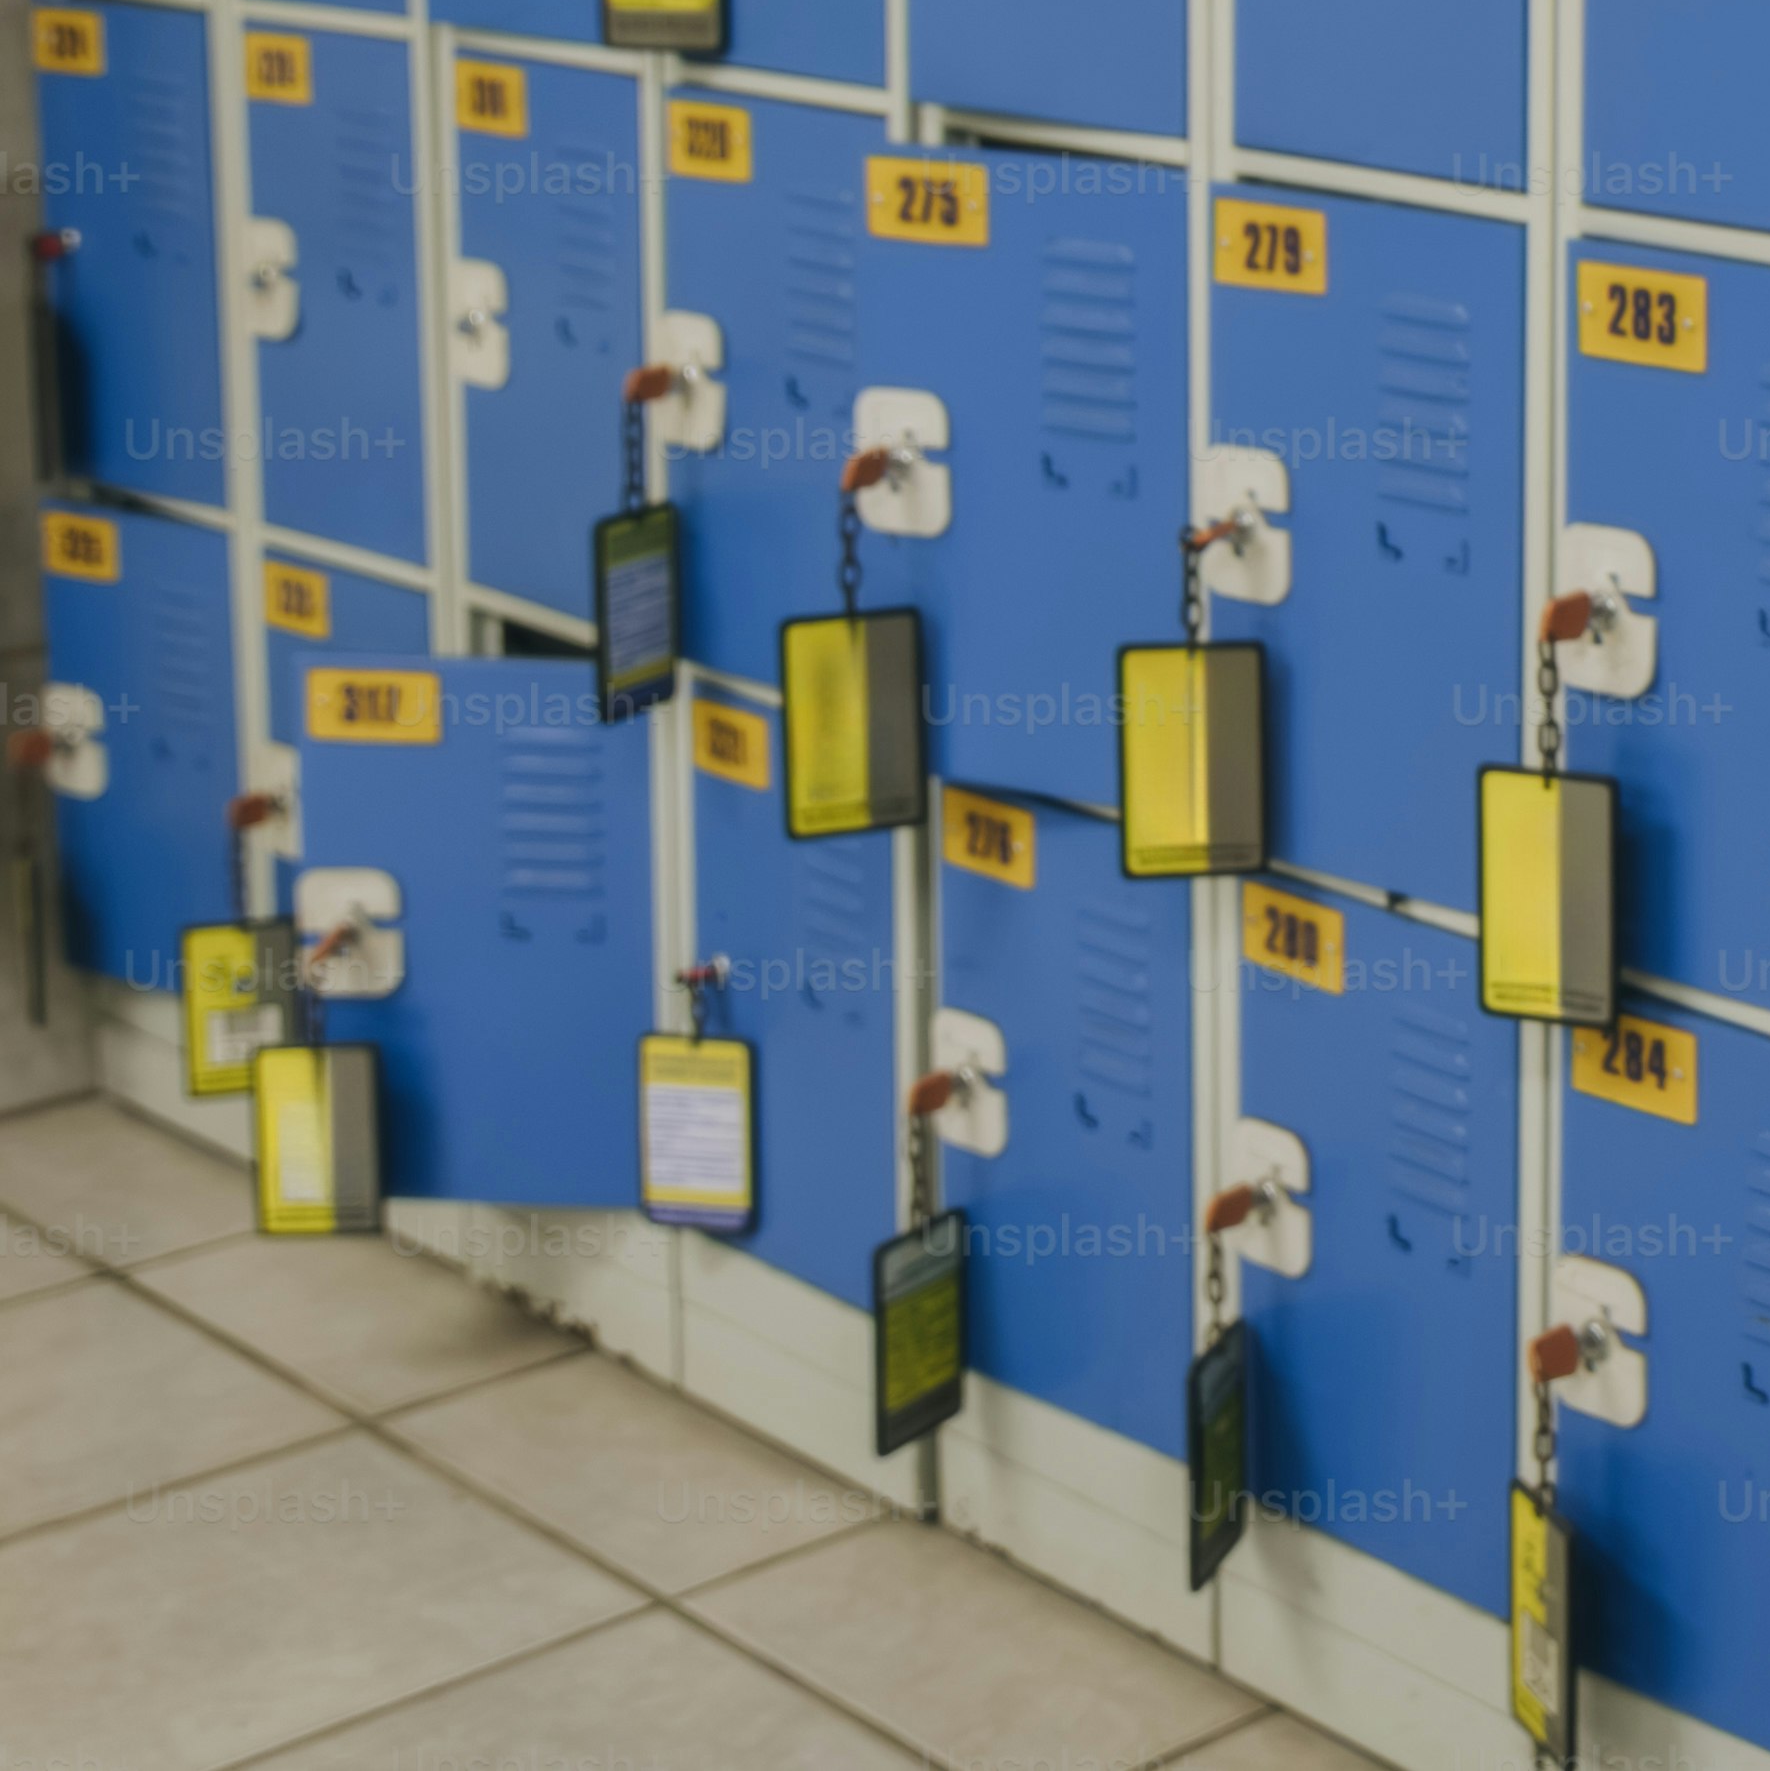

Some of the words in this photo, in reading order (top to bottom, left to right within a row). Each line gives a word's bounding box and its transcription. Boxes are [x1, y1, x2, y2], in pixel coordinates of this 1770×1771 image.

[898, 177, 959, 227] 275
[1244, 222, 1302, 275] 279
[1609, 284, 1677, 346] 283
[1603, 1029, 1668, 1091] 284
